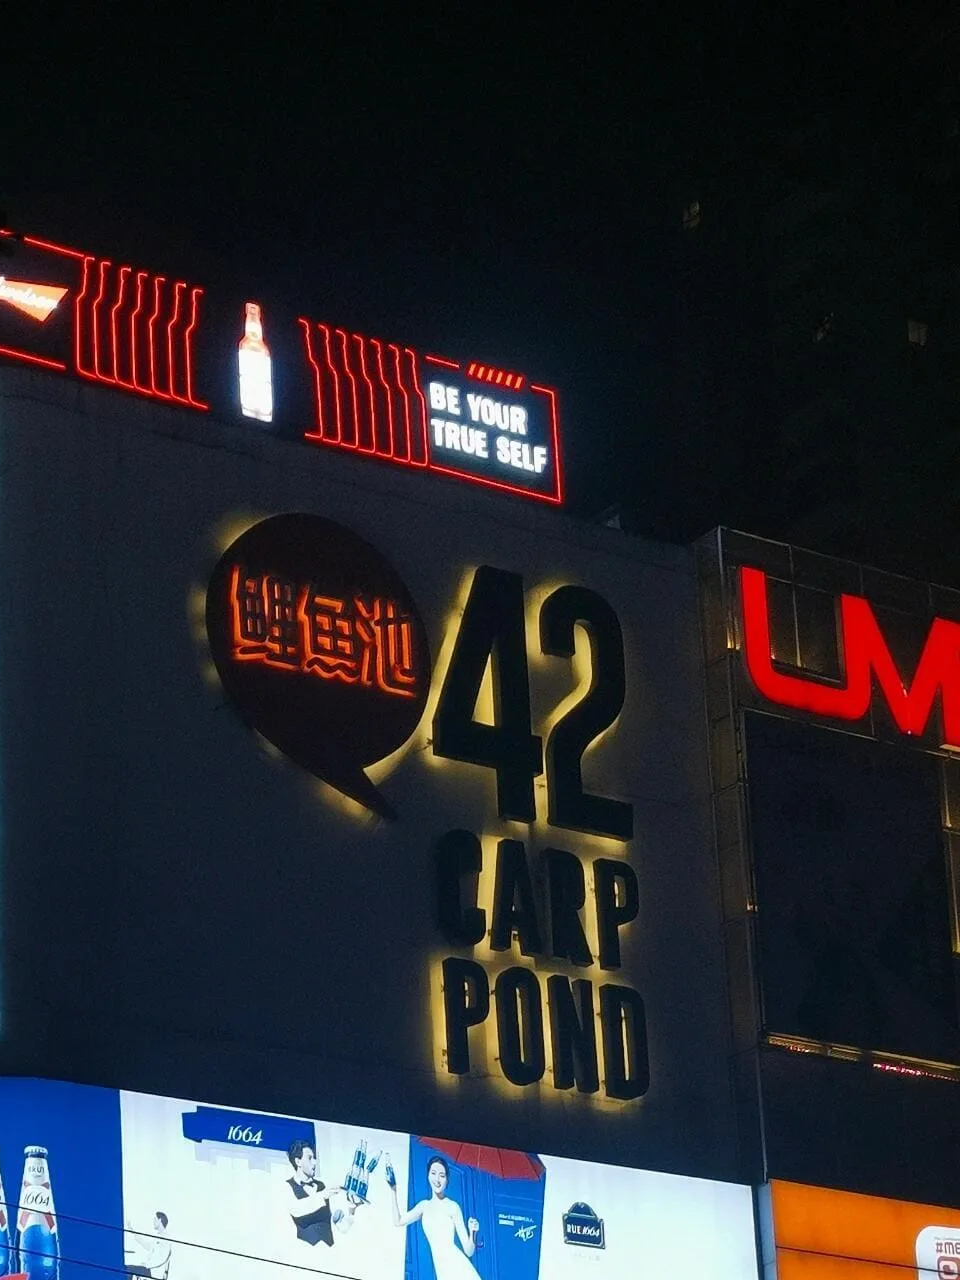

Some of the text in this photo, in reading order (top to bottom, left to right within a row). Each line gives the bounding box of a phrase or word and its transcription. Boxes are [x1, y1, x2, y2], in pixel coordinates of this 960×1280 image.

[430, 382, 528, 435] BE YOUR
[430, 418, 548, 473] TRUE SELF
[432, 564, 634, 842] 42
[441, 829, 638, 970] CARP
[442, 957, 650, 1100] POND
[227, 1125, 263, 1145] 1664
